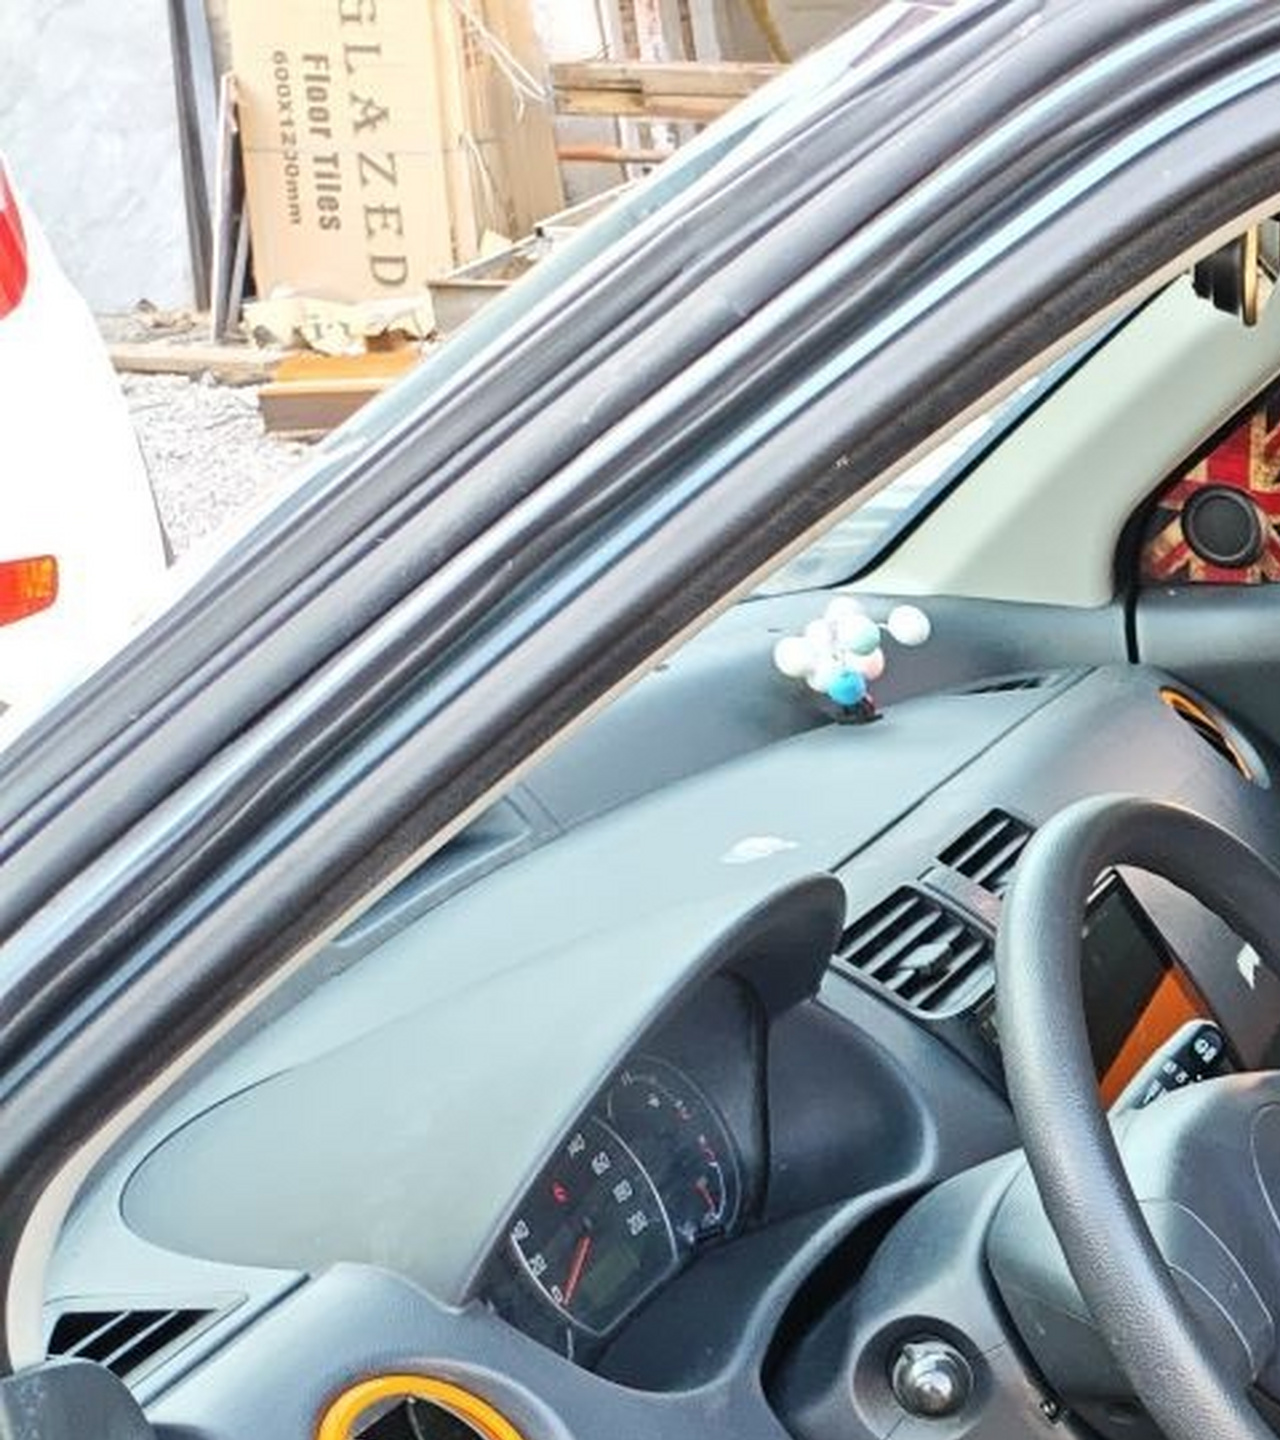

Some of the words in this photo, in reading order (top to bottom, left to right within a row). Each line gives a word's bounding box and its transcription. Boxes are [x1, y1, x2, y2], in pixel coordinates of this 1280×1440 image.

[302, 53, 332, 139] Floor
[338, 0, 409, 288] GLAZED
[313, 152, 342, 231] Tiles
